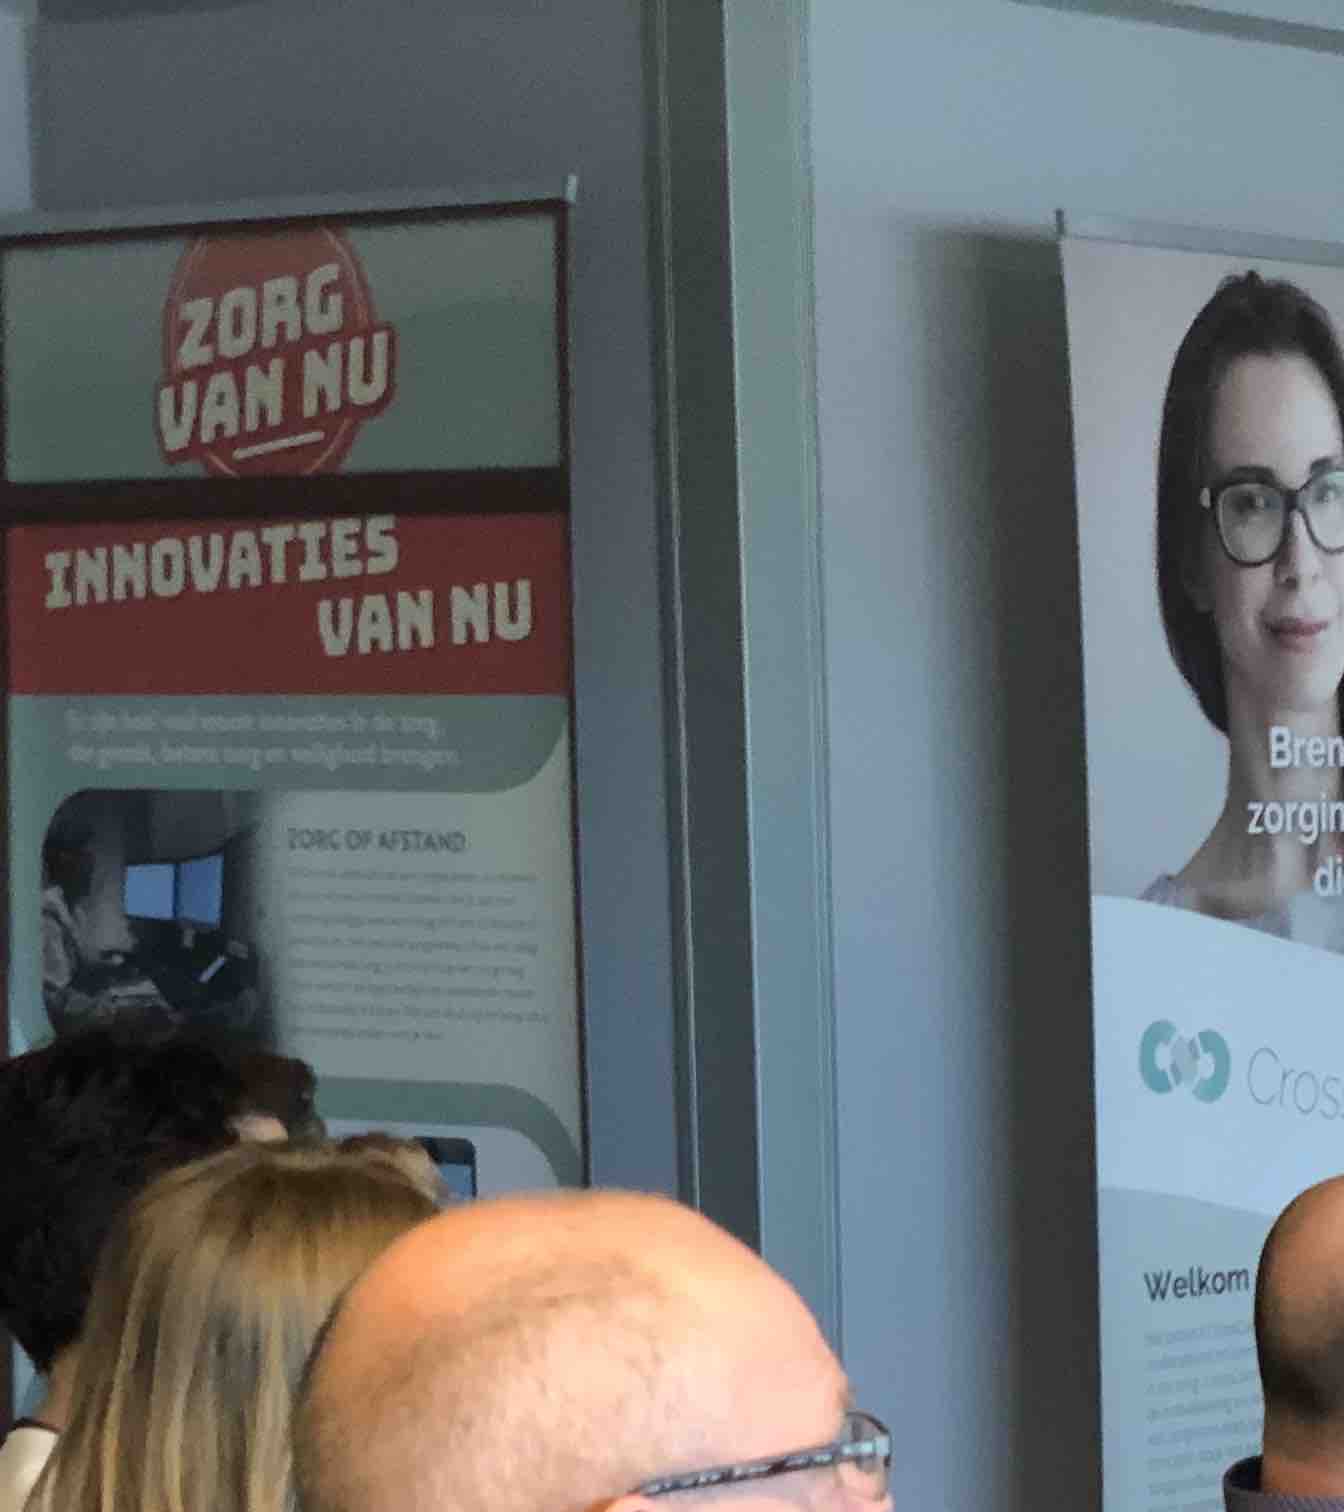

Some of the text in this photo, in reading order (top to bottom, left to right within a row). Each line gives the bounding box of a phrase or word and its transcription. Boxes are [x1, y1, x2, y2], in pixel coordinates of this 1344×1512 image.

[178, 263, 343, 368] ZORG
[160, 331, 388, 451] VAN NU
[45, 514, 399, 609] INNOVATIES
[317, 579, 533, 656] VAN NU
[1144, 1267, 1250, 1301] Welkom
